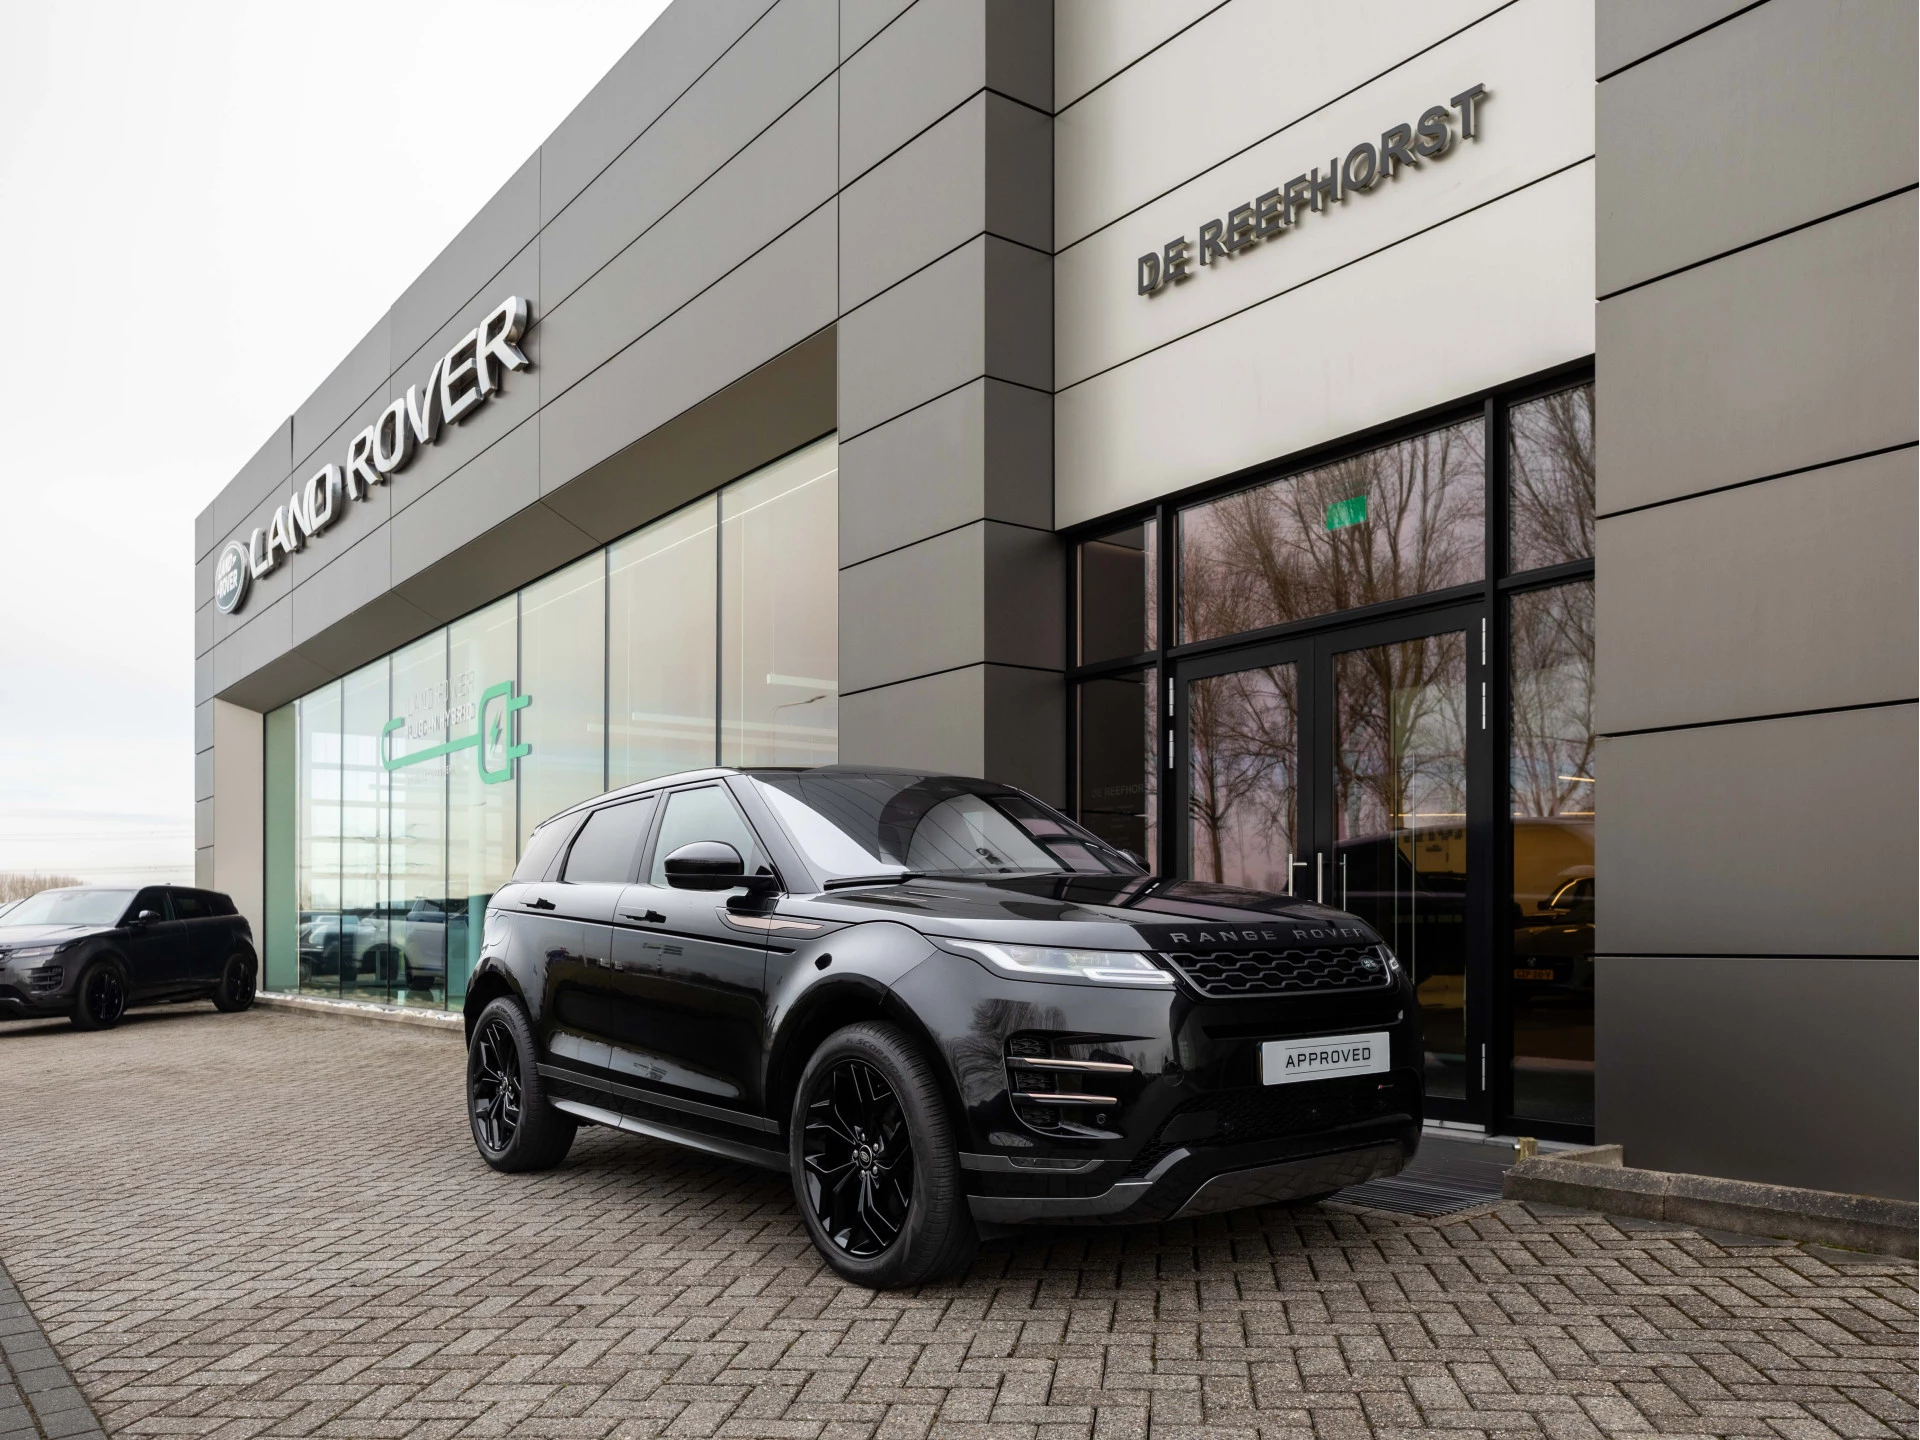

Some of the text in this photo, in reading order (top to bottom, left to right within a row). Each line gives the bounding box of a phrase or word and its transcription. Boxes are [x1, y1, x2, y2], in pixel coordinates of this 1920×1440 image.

[1137, 83, 1486, 296] DE REEFHORST
[249, 295, 530, 580] LAND ROVER
[219, 569, 238, 599] ROVER
[1170, 927, 1365, 944] RANGE ROVER
[1285, 1047, 1372, 1068] APPROVED
